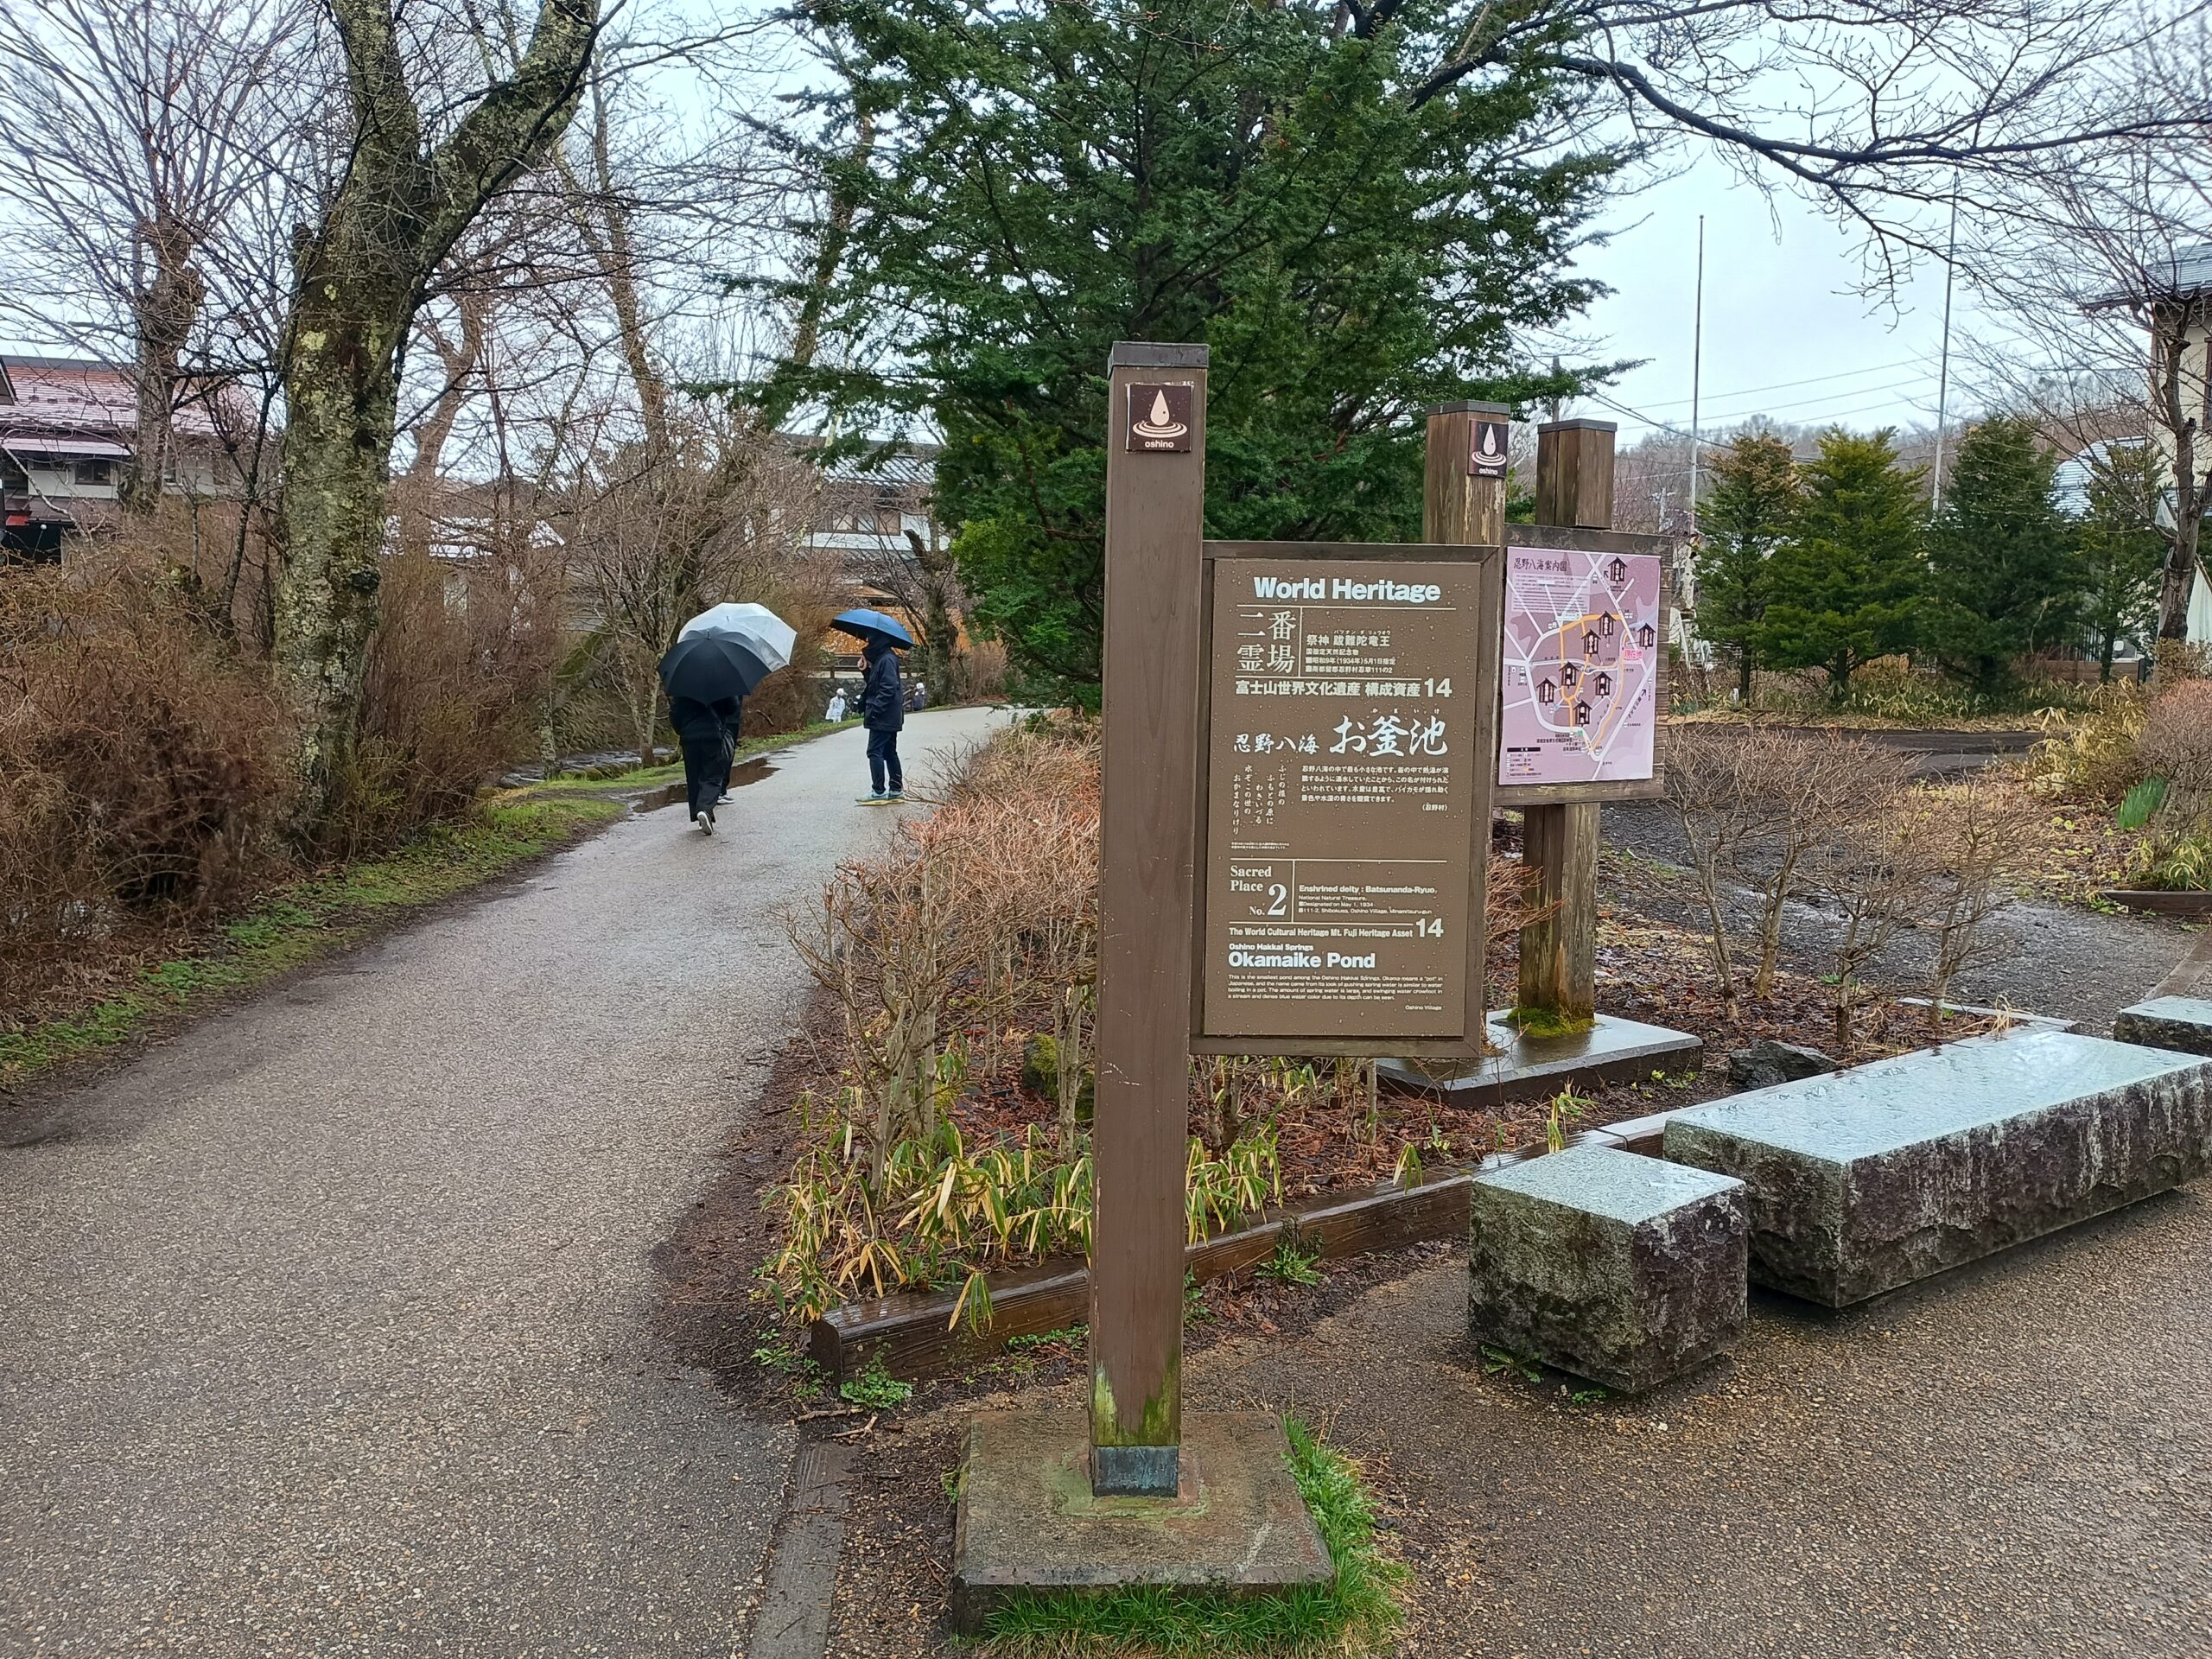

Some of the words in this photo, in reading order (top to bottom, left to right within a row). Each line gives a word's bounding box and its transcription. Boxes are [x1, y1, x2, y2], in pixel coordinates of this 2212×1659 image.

[1514, 558, 1568, 571] 忍野八海案内図
[1254, 577, 1325, 600] World
[1332, 579, 1440, 602] Heritage
[1238, 611, 1296, 639] 二番
[1306, 635, 1329, 645] 祭神
[1236, 644, 1295, 673] 霊場
[1236, 680, 1360, 696] 富士山世界文化遺産
[1365, 683, 1420, 696] 構成資産
[1425, 678, 1452, 697] 14
[1234, 734, 1319, 755] 忍野八海
[1330, 715, 1447, 757] お釜池
[1230, 866, 1271, 877] Sacred
[1230, 880, 1263, 891] Place
[1249, 905, 1265, 915] No.
[1268, 884, 1287, 915] 2
[1298, 928, 1329, 937] Heritage
[1359, 929, 1390, 938] Heritage
[1416, 918, 1444, 937] 14
[1229, 951, 1321, 967] Okamaike
[1327, 953, 1375, 968] Pond
